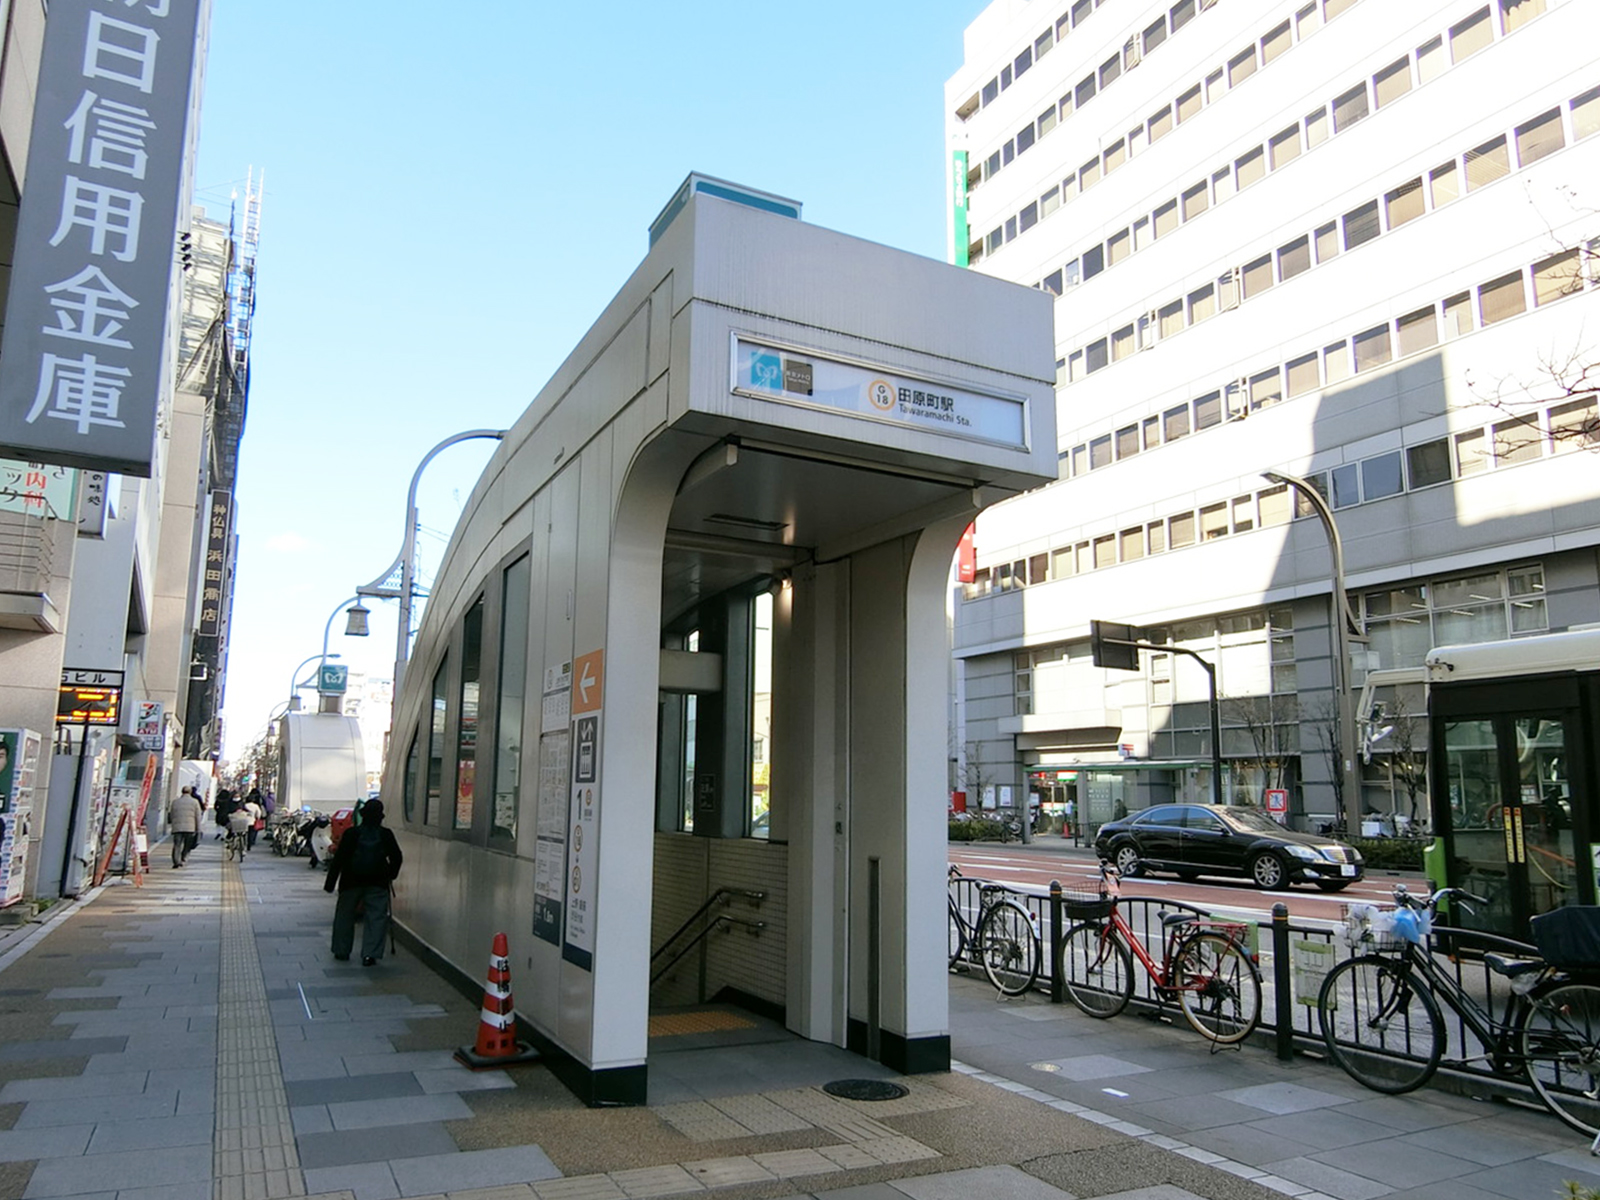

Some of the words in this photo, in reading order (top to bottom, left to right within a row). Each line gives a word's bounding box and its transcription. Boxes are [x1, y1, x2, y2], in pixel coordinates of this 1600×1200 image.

[25, 0, 170, 435] 日信用金庫
[876, 394, 889, 405] 18
[877, 385, 886, 394] G
[898, 387, 954, 413] 田原町駅
[898, 403, 954, 423] Tawaramachi
[956, 415, 972, 427] Sta.
[211, 504, 226, 539] 神仏具
[202, 550, 223, 622] 浜田商店
